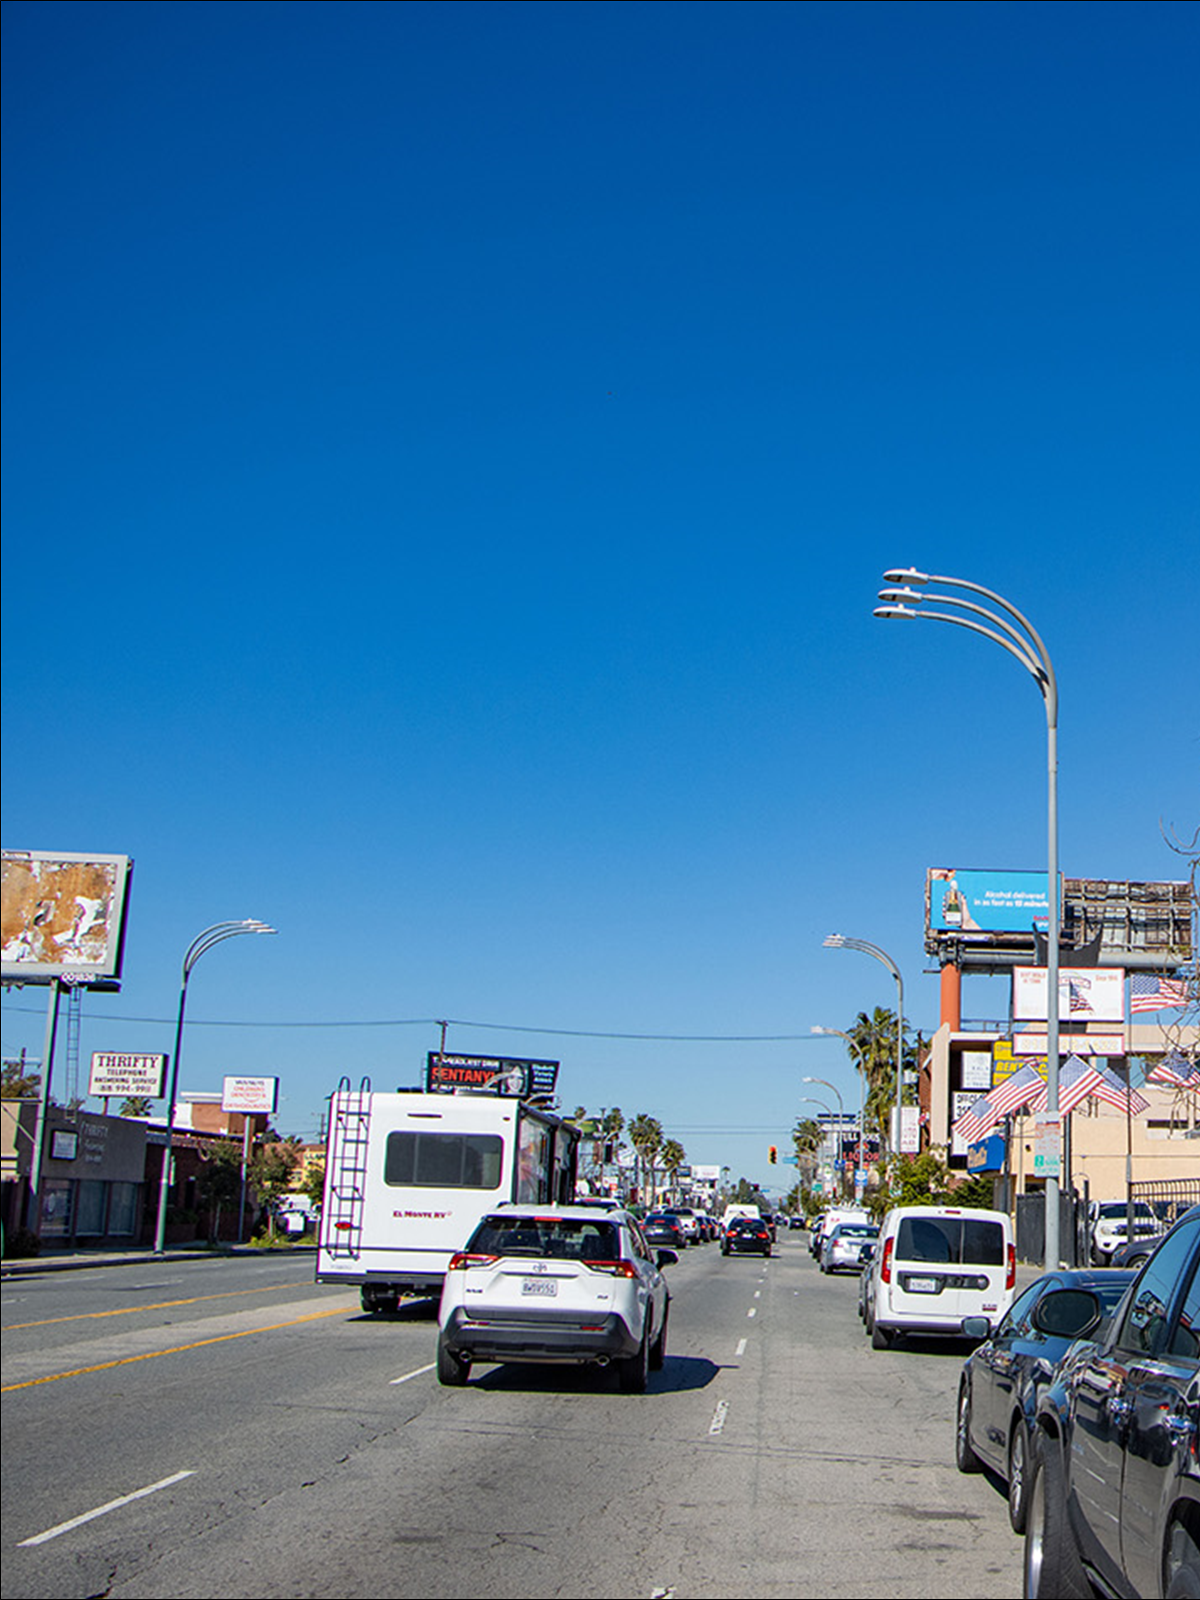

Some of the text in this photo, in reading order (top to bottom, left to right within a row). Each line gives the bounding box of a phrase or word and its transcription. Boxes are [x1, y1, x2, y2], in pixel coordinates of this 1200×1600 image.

[984, 890, 1046, 900] Alcohol delivered
[97, 1055, 160, 1069] THRIFTY
[107, 1068, 148, 1077] TELEPHONE
[431, 1066, 499, 1084] FENTANY
